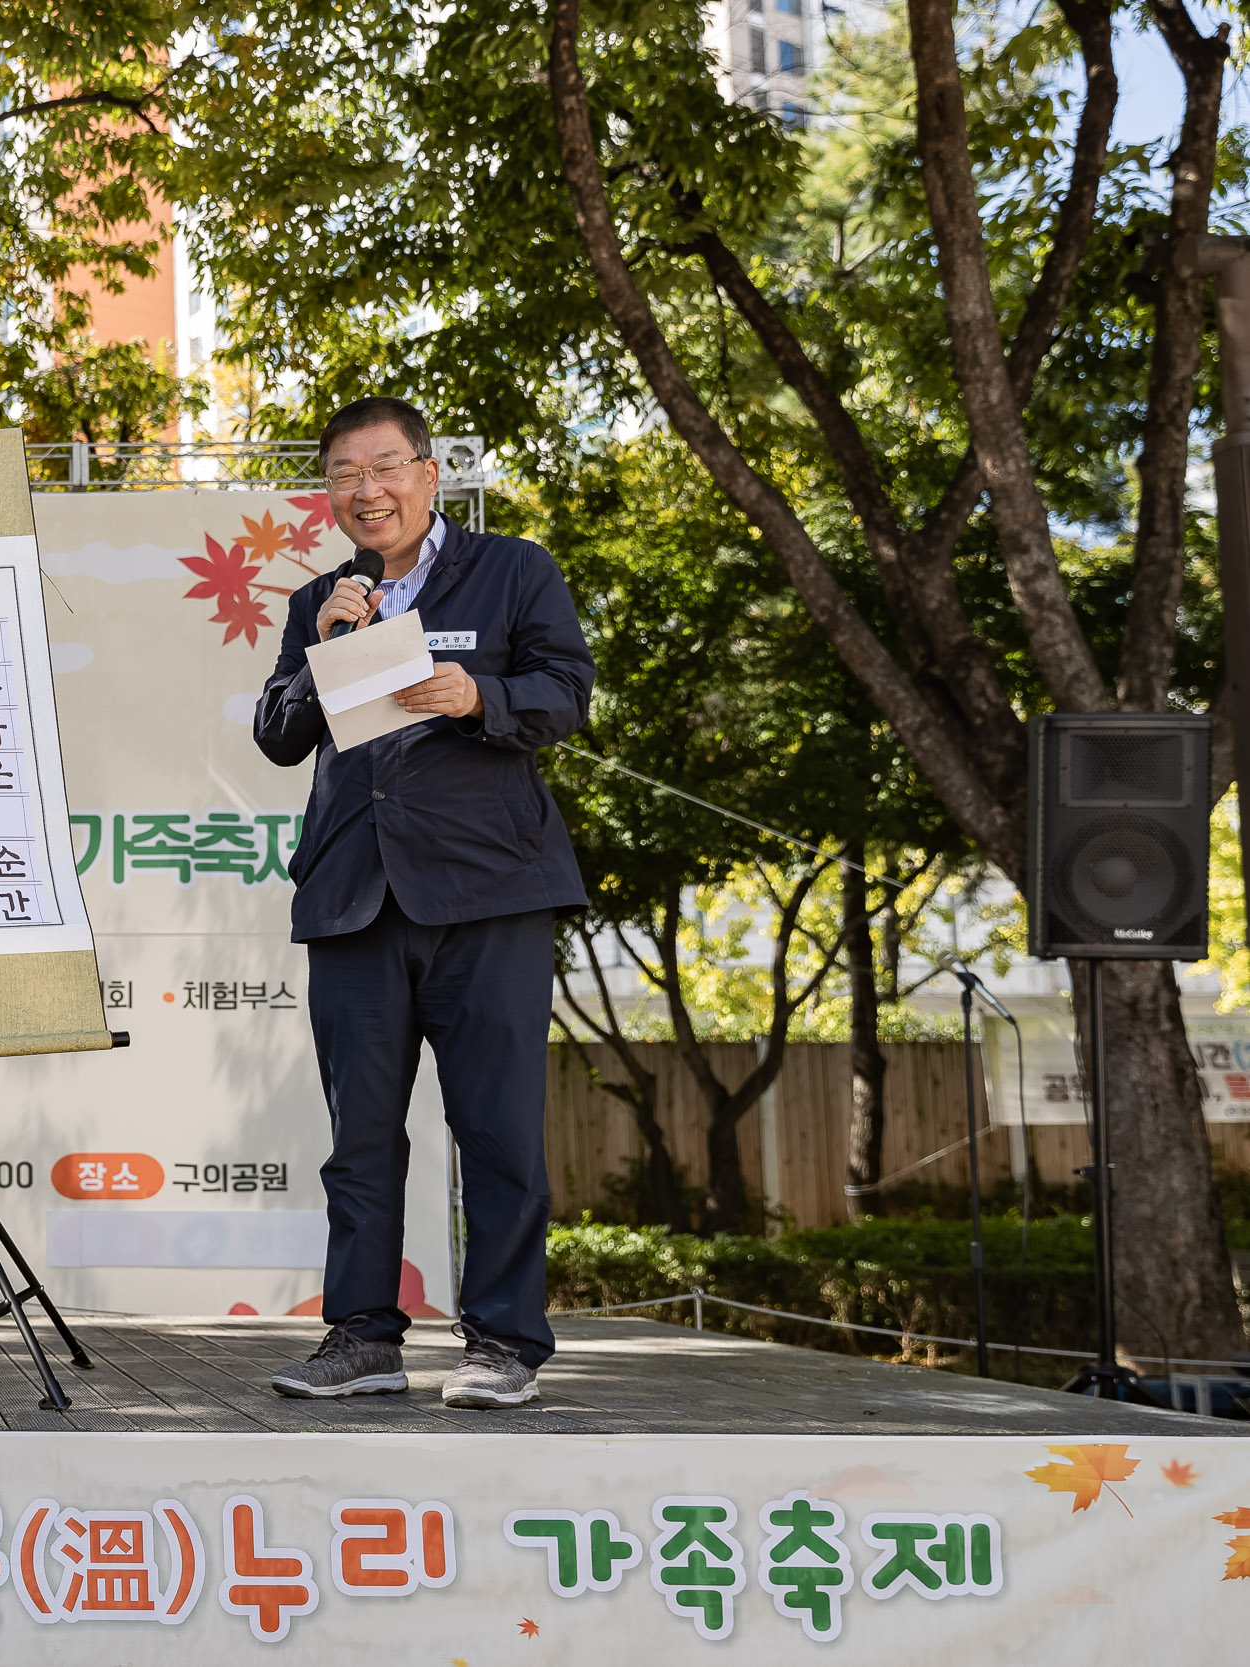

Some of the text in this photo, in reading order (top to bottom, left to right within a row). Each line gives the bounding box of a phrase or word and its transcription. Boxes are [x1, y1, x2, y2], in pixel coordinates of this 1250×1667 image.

[182, 981, 298, 1010] 체험부스
[78, 1160, 141, 1192] 장소
[172, 1162, 289, 1193] 구의공원
[512, 1497, 993, 1634] 가족축제
